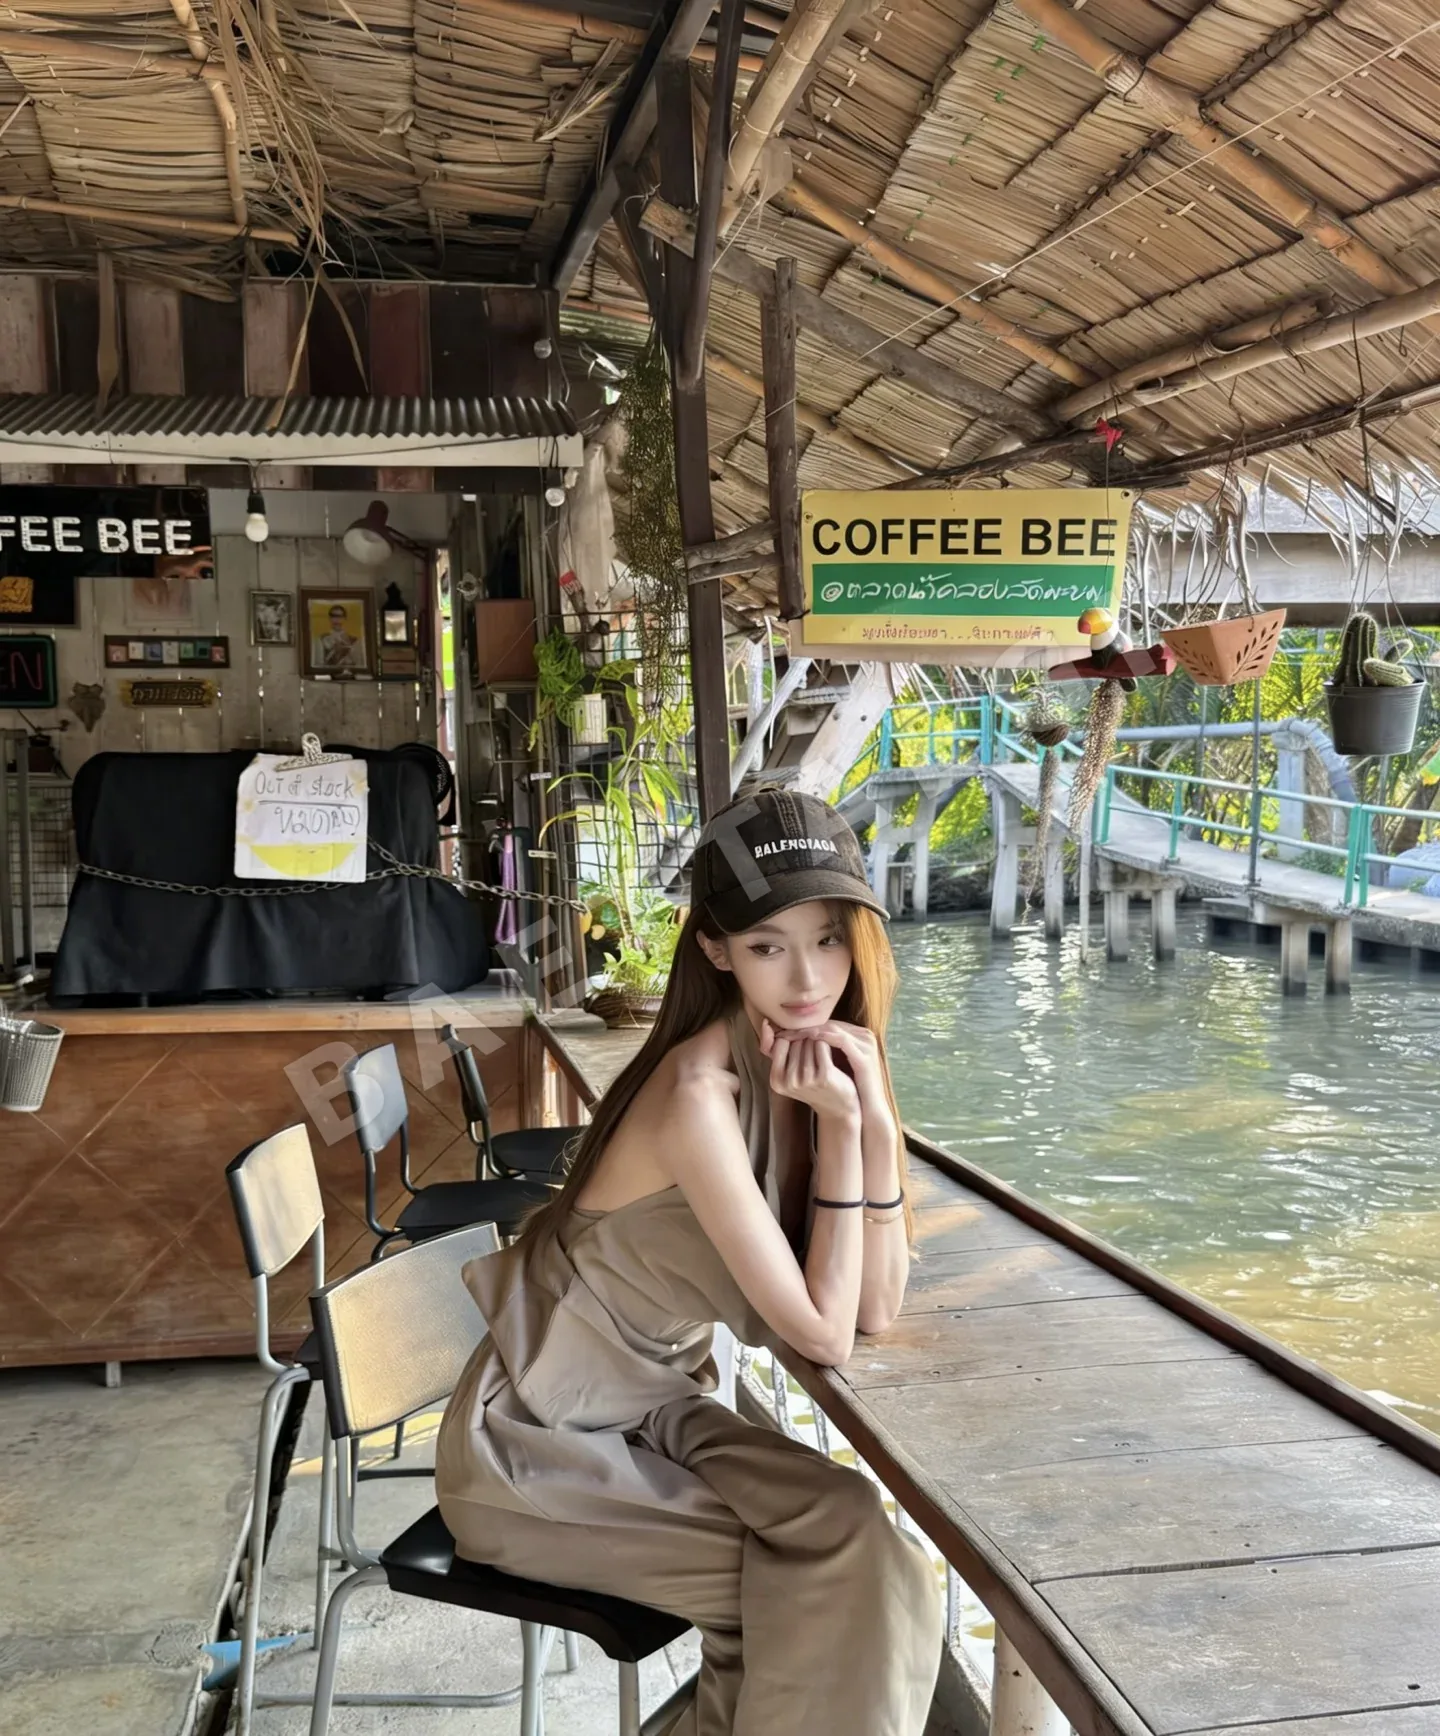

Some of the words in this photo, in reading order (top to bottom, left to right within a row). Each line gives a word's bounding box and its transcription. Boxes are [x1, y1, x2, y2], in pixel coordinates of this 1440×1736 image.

[97, 517, 194, 555] BEE
[812, 518, 1002, 557] COFFEE
[1021, 518, 1117, 557] BEE
[255, 771, 285, 795] Out
[288, 773, 302, 796] of
[308, 774, 355, 798] stock
